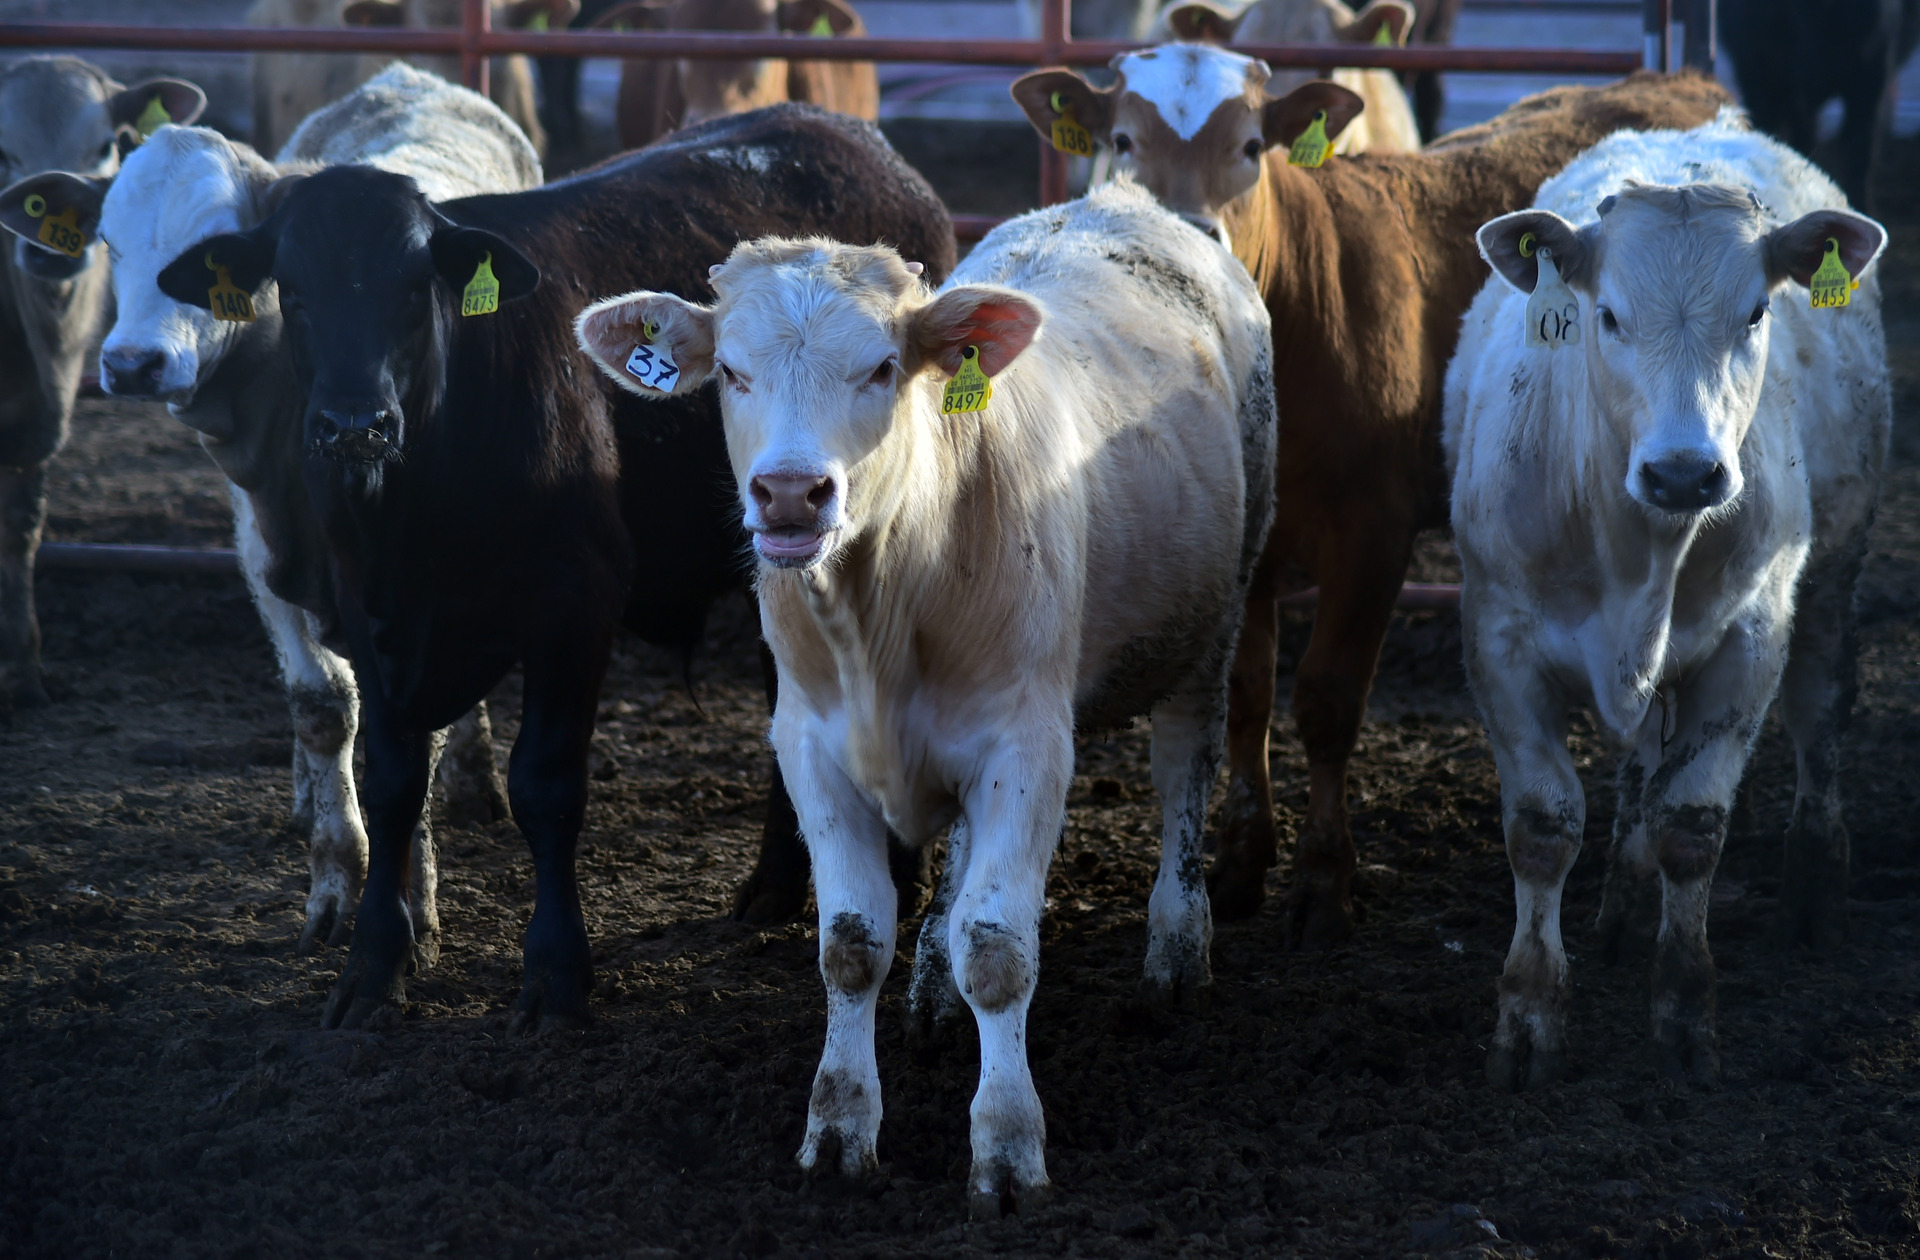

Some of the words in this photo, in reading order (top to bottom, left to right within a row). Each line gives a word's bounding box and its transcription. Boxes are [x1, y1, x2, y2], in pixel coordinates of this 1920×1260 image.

[1058, 126, 1088, 153] 136
[49, 223, 82, 252] 139
[215, 291, 250, 317] 140
[464, 294, 494, 314] 8475
[1812, 287, 1845, 307] 8455
[628, 344, 679, 384] 37
[944, 391, 984, 412] 8497
